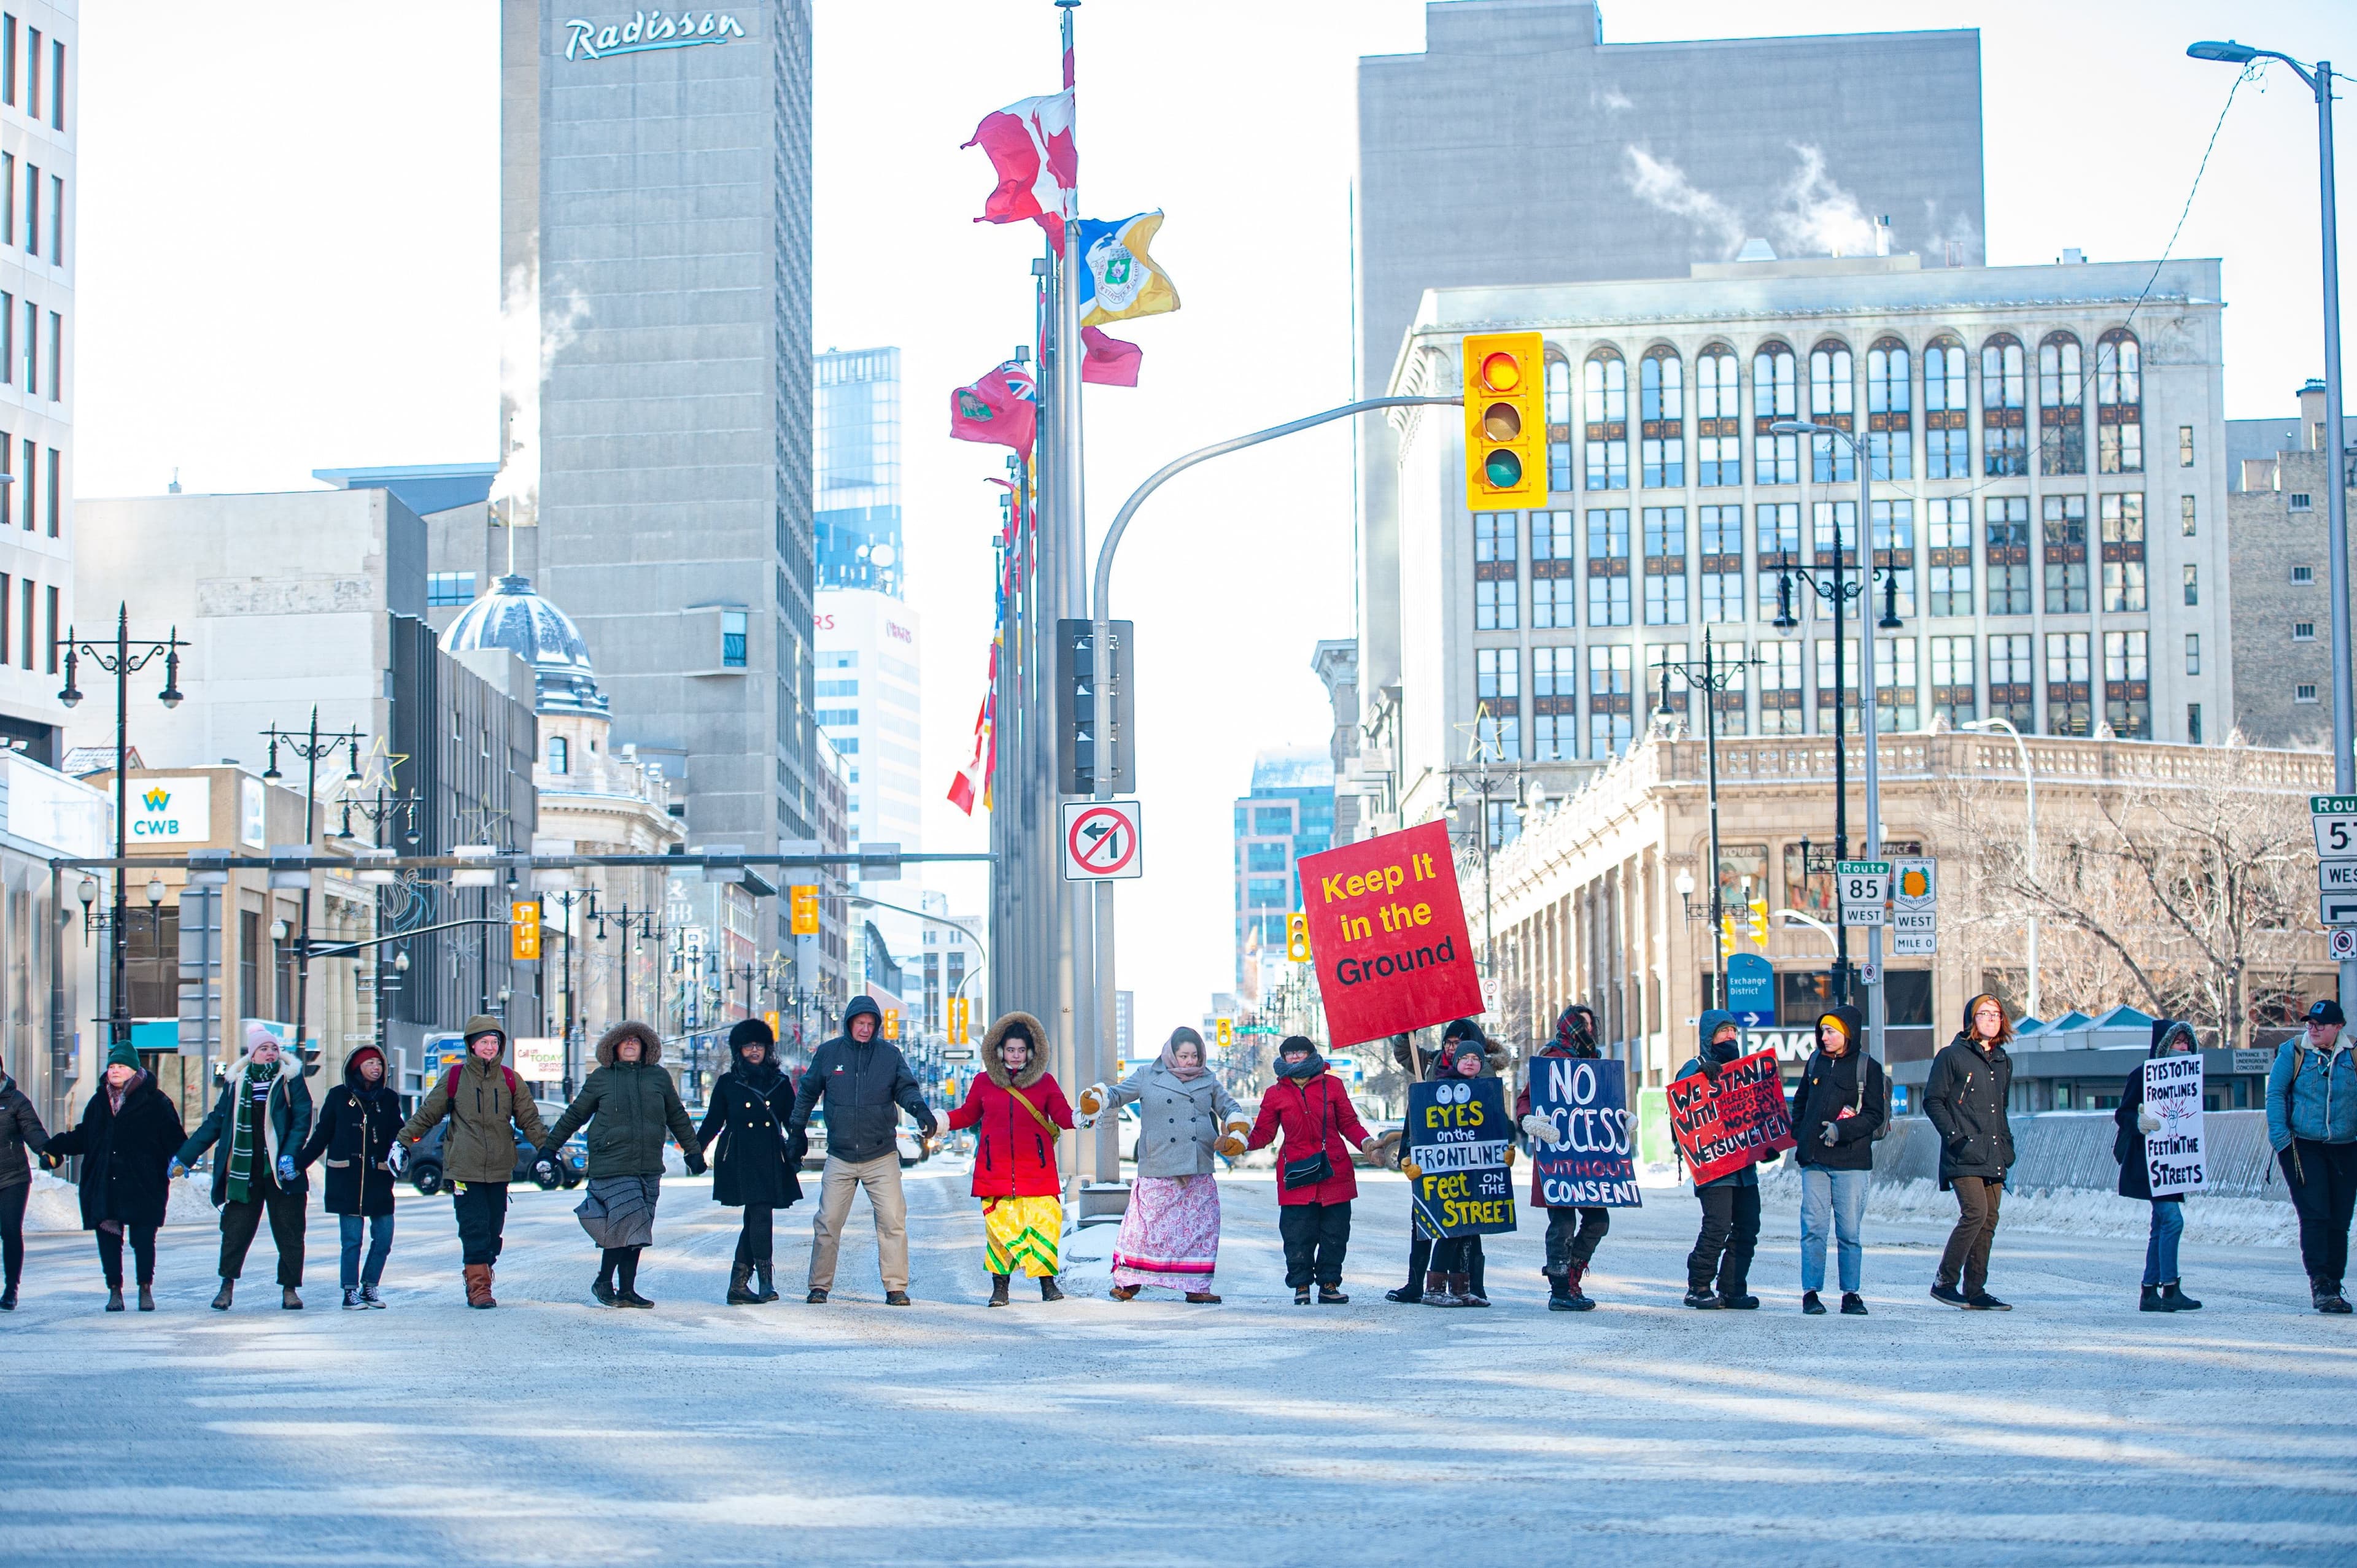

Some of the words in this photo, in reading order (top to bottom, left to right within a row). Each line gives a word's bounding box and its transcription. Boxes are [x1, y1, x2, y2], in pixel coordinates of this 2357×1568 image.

[565, 10, 745, 61] Radisson
[2317, 798, 2357, 813] Rou
[134, 820, 179, 835] CWB
[2330, 822, 2357, 850] 5
[1721, 846, 1753, 857] YOUR
[1880, 843, 1910, 854] FFICE
[1843, 863, 1884, 873] Route
[2329, 868, 2357, 882] WES
[1322, 865, 1404, 904] Keep
[1412, 853, 1436, 882] It
[1849, 879, 1878, 899] 85
[1898, 896, 1931, 905] MANITOBA
[1340, 914, 1372, 942] in
[1379, 903, 1432, 933] the
[1847, 911, 1881, 921] WEST
[1898, 917, 1932, 927] WEST
[1898, 940, 1921, 948] MILE
[1926, 939, 1932, 948] 0
[1336, 935, 1455, 986] Ground
[1730, 977, 1767, 987] Exchange
[1730, 987, 1759, 995] District
[2145, 1062, 2168, 1082] EYES
[2169, 1062, 2181, 1078] TO
[2181, 1060, 2200, 1076] THE
[1549, 1059, 1596, 1105] NO
[1670, 1082, 1702, 1114] WE
[1708, 1056, 1778, 1100] STAND
[2146, 1082, 2197, 1102] FRONTLINES
[1425, 1101, 1484, 1129] EYES
[1674, 1100, 1719, 1136] WITH
[1437, 1131, 1453, 1142] on
[1453, 1128, 1476, 1141] the
[1535, 1105, 1630, 1155] ACCESS
[2148, 1138, 2170, 1157] FEET
[2169, 1137, 2180, 1156] IN
[2179, 1136, 2199, 1154] THE
[1483, 1172, 1504, 1183] ON
[1538, 1159, 1631, 1176] WITHOUT
[2150, 1160, 2203, 1188] STREETS
[1422, 1172, 1471, 1201] Feet
[1479, 1183, 1506, 1195] THE
[1543, 1179, 1638, 1203] CONSENT
[1442, 1199, 1514, 1228] STREET
